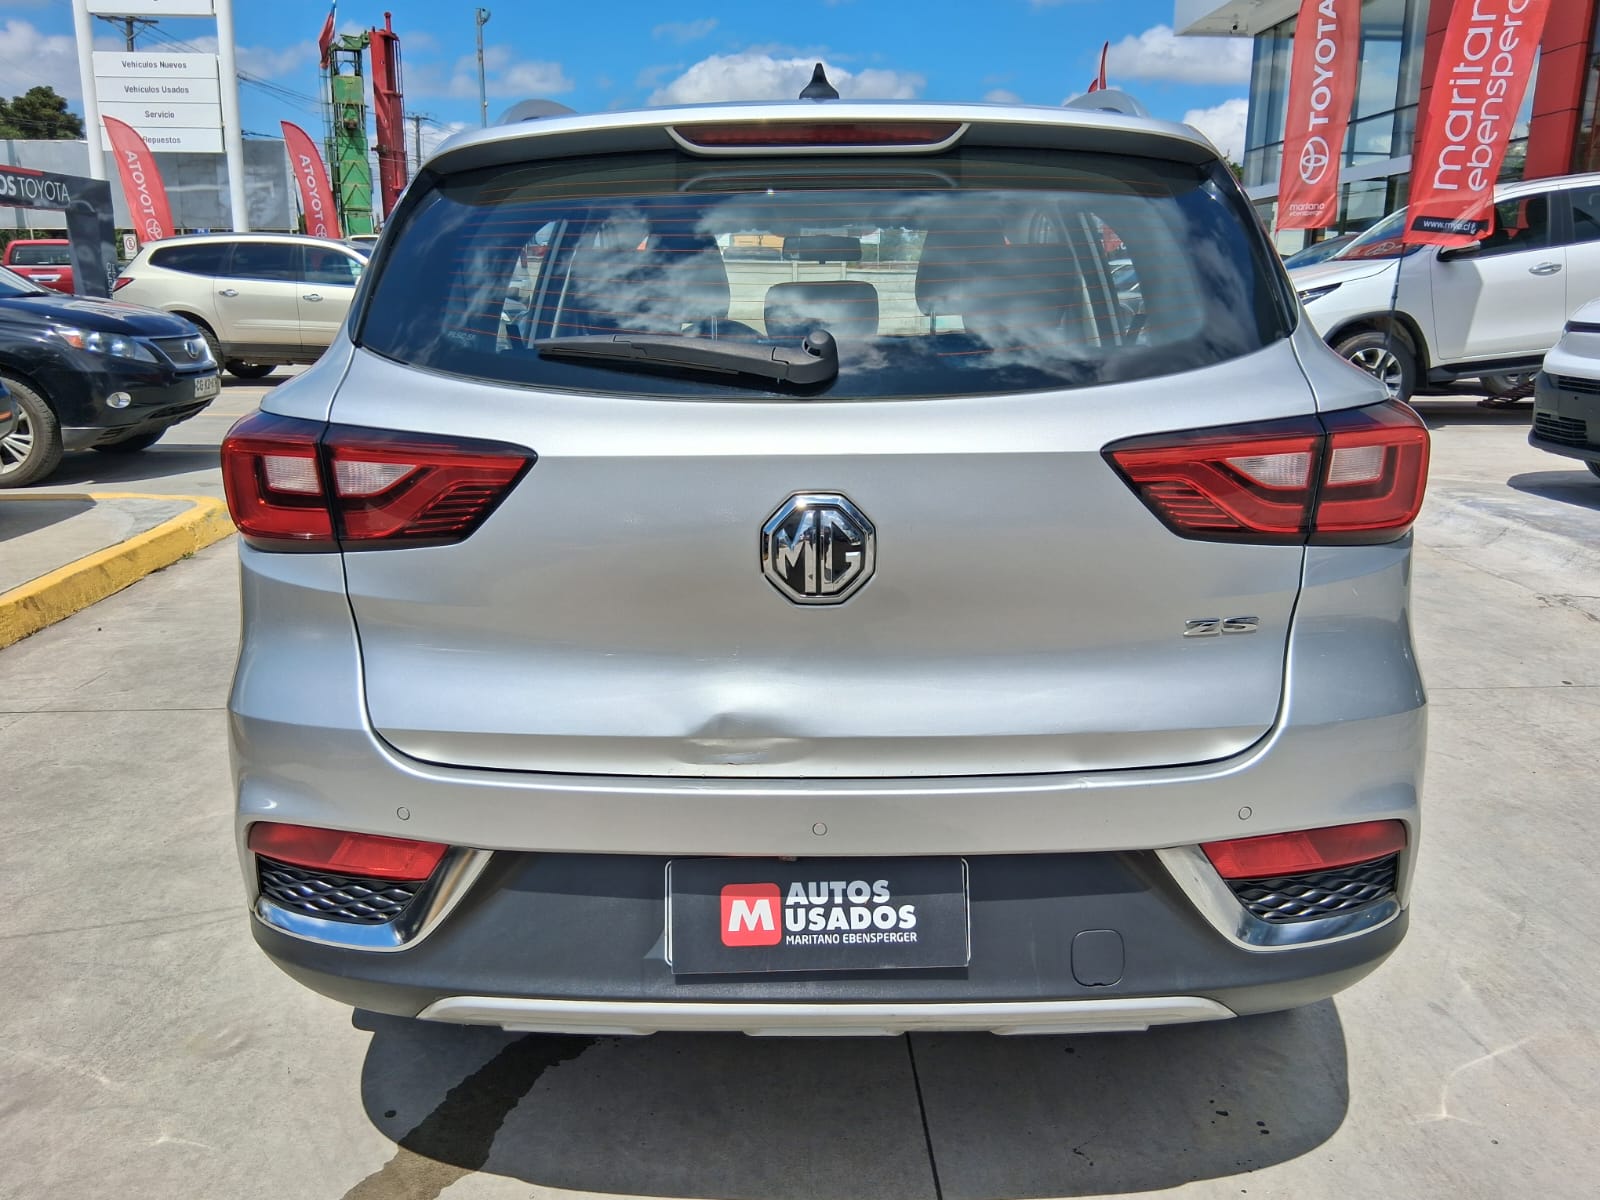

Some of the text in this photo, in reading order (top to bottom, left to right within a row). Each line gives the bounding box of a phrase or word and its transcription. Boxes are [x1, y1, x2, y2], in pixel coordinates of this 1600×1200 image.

[159, 61, 187, 69] Nuevos
[1308, 0, 1337, 132] TOYOTA
[161, 86, 190, 94] Usados
[144, 110, 175, 118] Servicio
[17, 177, 71, 202] TOYOTA
[775, 509, 861, 594] MG
[1183, 616, 1259, 637] ZS
[785, 879, 890, 905] AUTOS
[727, 899, 776, 932] M
[785, 904, 917, 932] USADOS
[785, 931, 918, 945] MARITANO EBENSPERGER
